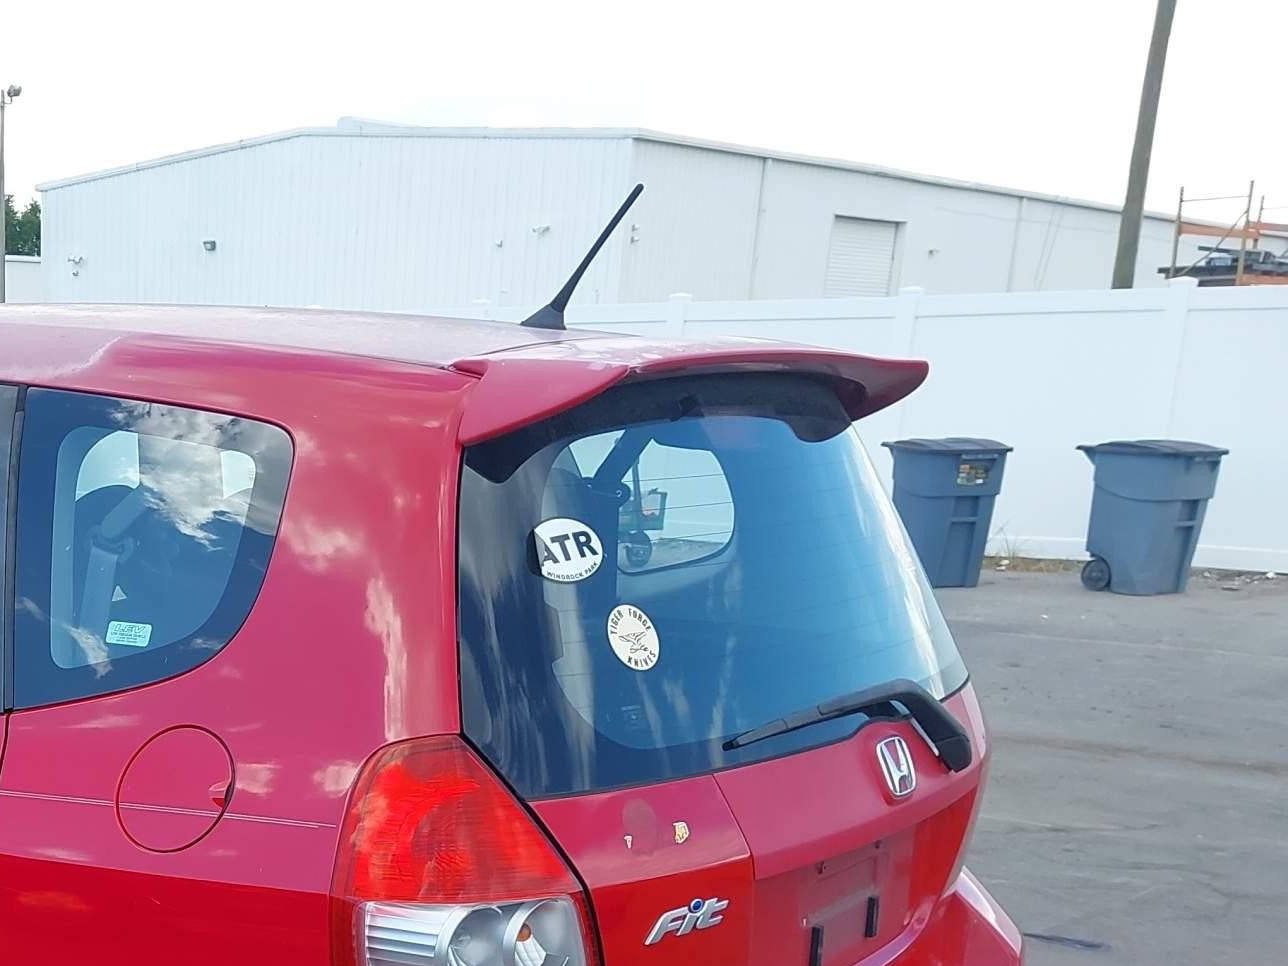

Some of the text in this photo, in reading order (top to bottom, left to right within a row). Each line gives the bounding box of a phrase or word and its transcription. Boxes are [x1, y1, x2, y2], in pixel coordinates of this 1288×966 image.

[541, 530, 599, 567] ATR
[609, 608, 651, 635] TIGER FORGE
[627, 650, 656, 667] KNIVES
[643, 897, 729, 946] Fit
